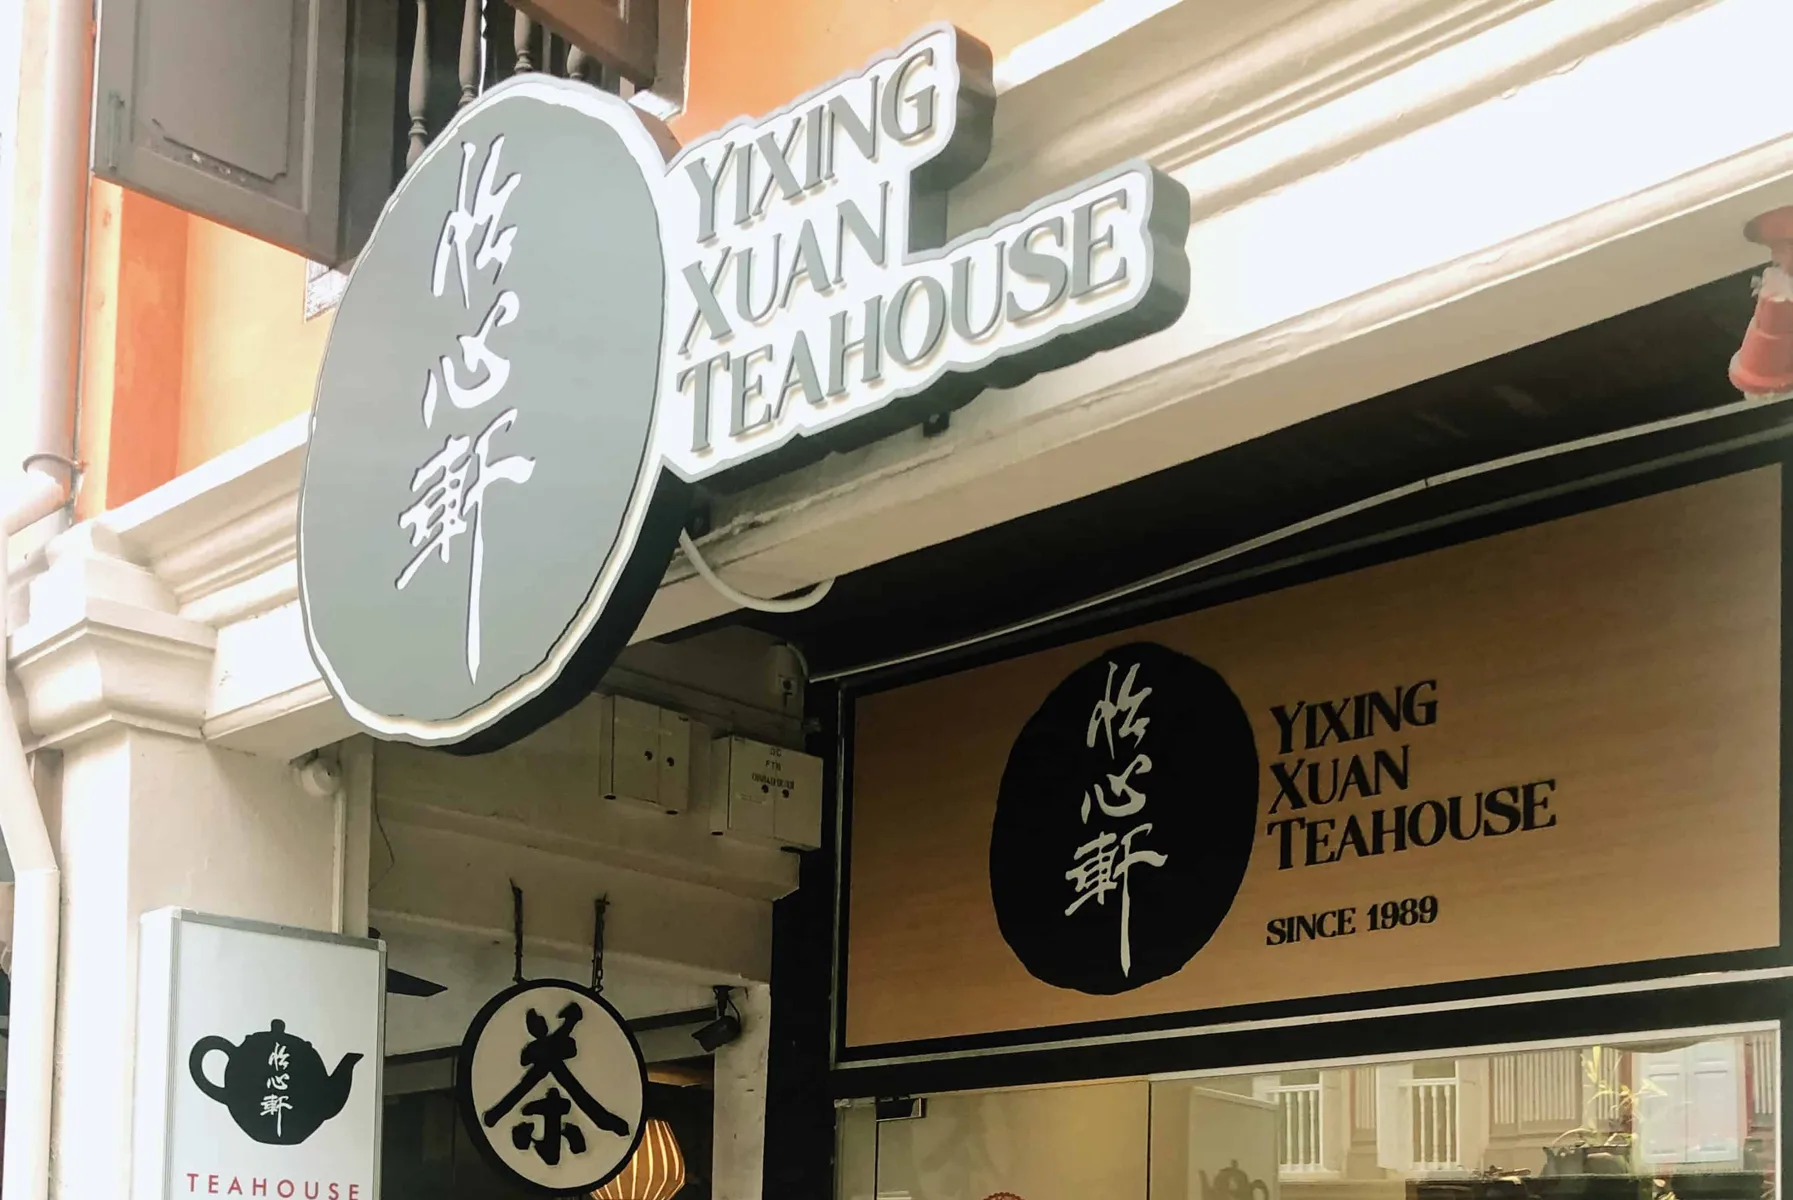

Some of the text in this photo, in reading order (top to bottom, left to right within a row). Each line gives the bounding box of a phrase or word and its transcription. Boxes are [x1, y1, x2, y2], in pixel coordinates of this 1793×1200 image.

[684, 46, 939, 243] YIXING
[676, 189, 1130, 452] TEAHOUSE
[679, 181, 892, 354] XUAN
[1267, 745, 1410, 816] XUAN
[1268, 679, 1438, 756] YIXING
[1266, 778, 1557, 870] TEAHOUSE
[1265, 895, 1439, 947] SINCE 1989
[484, 1002, 630, 1165] 茶
